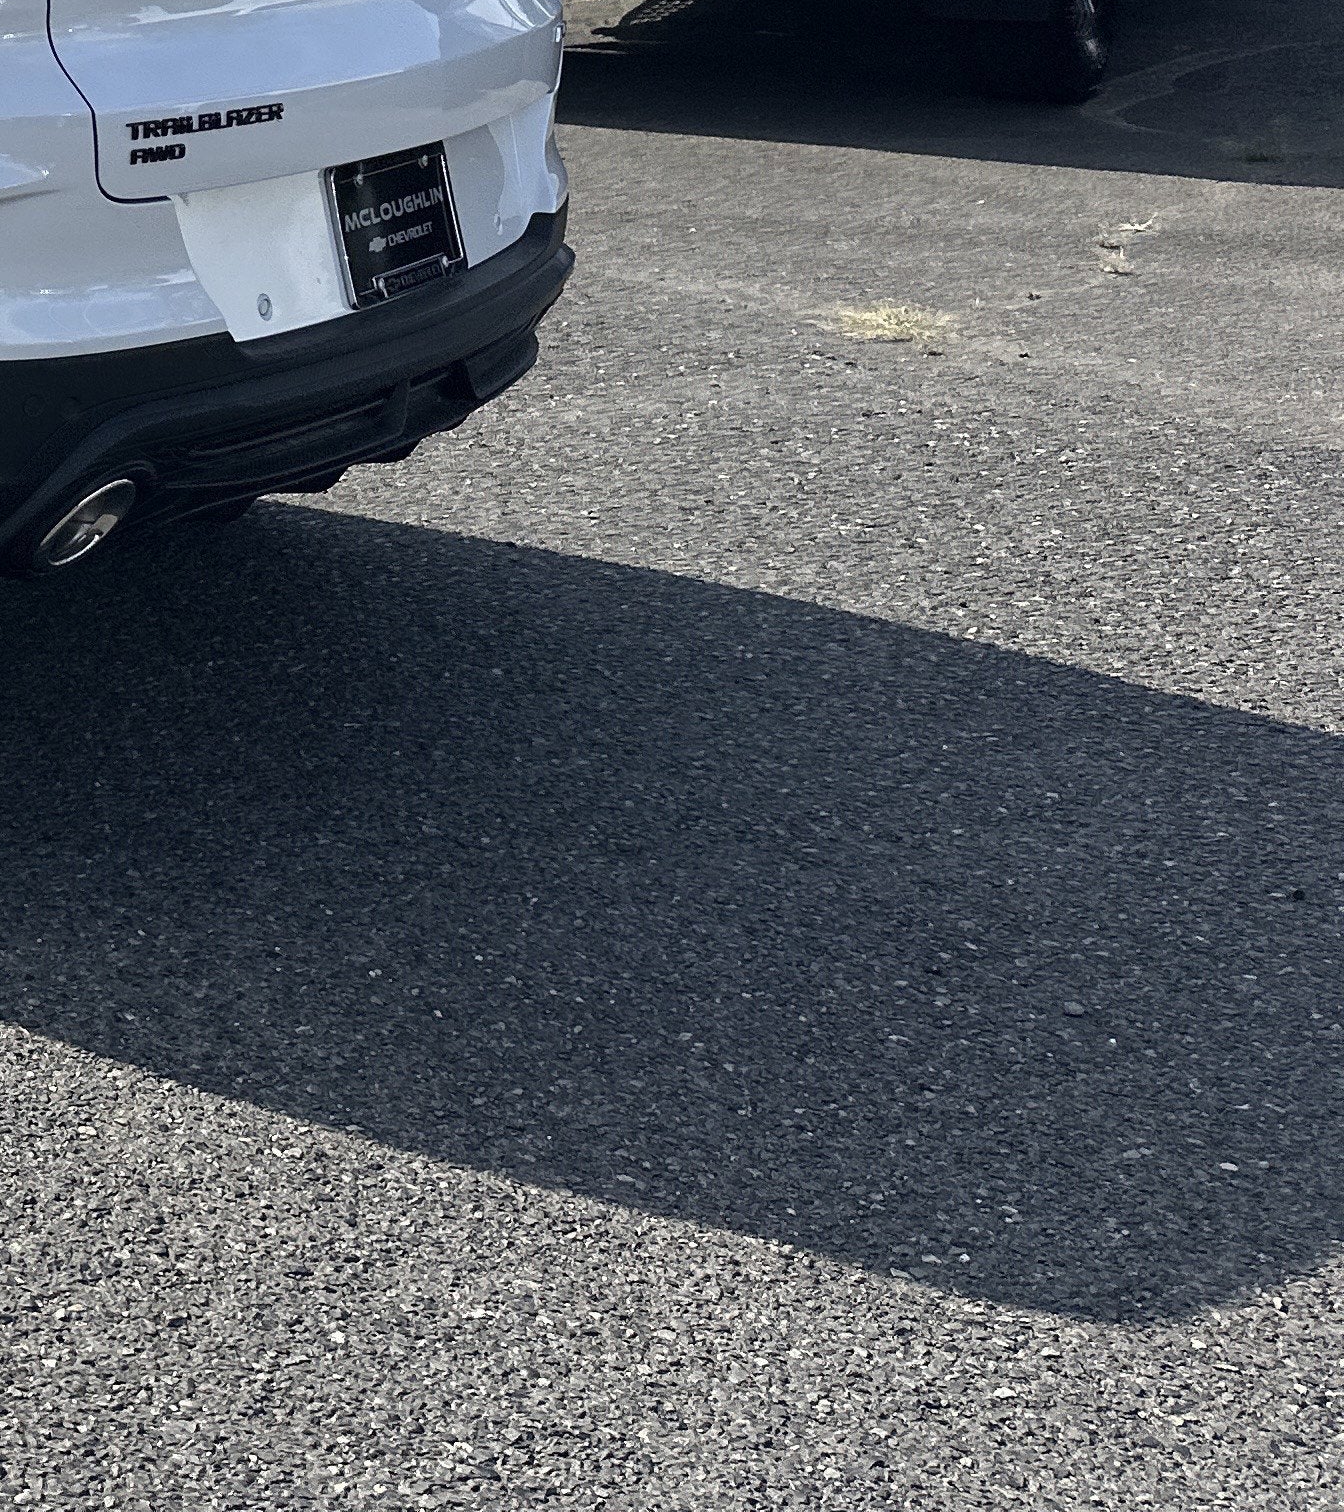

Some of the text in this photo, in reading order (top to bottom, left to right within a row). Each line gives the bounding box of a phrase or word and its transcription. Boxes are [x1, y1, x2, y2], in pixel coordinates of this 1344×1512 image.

[125, 102, 285, 141] TRAILBLAZER
[129, 143, 187, 166] AWD
[344, 185, 444, 233] MCLOUGHLIN
[387, 221, 433, 247] CHEVROLET
